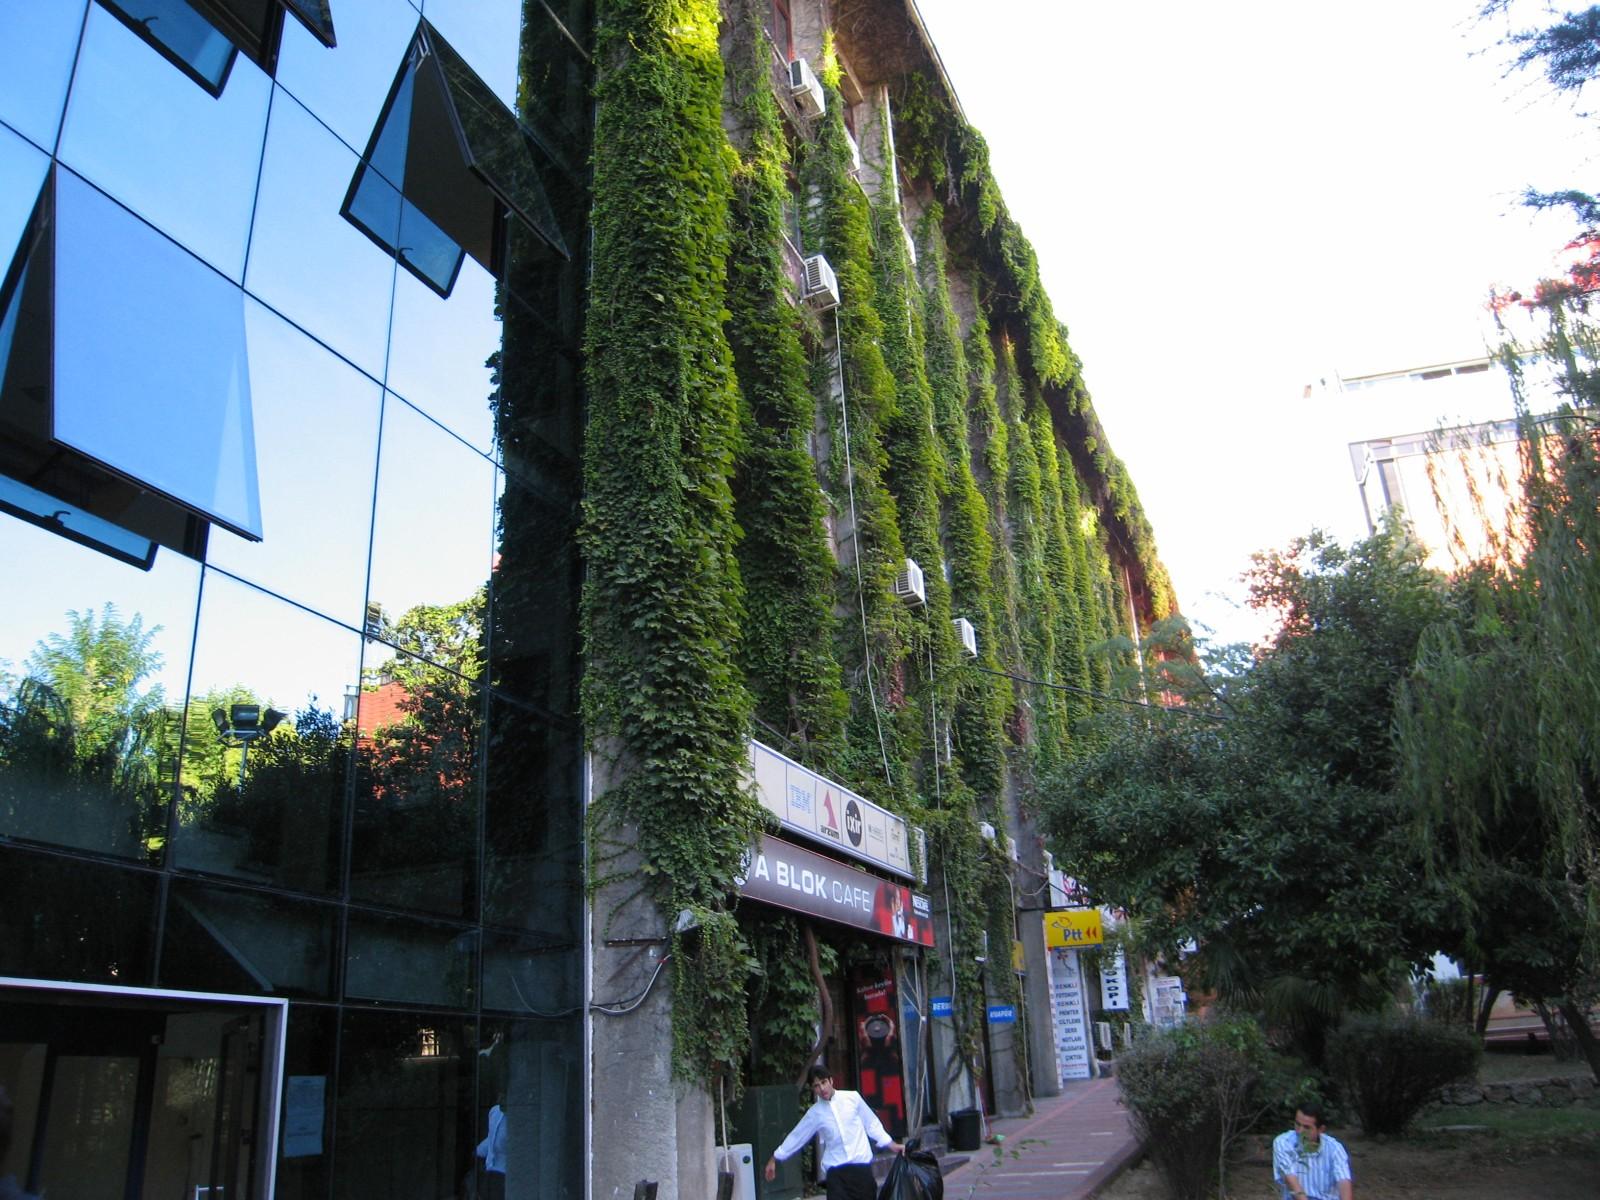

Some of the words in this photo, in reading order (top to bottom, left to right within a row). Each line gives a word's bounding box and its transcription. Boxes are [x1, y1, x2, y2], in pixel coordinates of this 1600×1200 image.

[846, 809, 862, 834] ixir
[755, 855, 769, 881] A
[776, 861, 827, 899] BLOK
[832, 881, 871, 912] CAFE
[1063, 928, 1083, 941] Ptt
